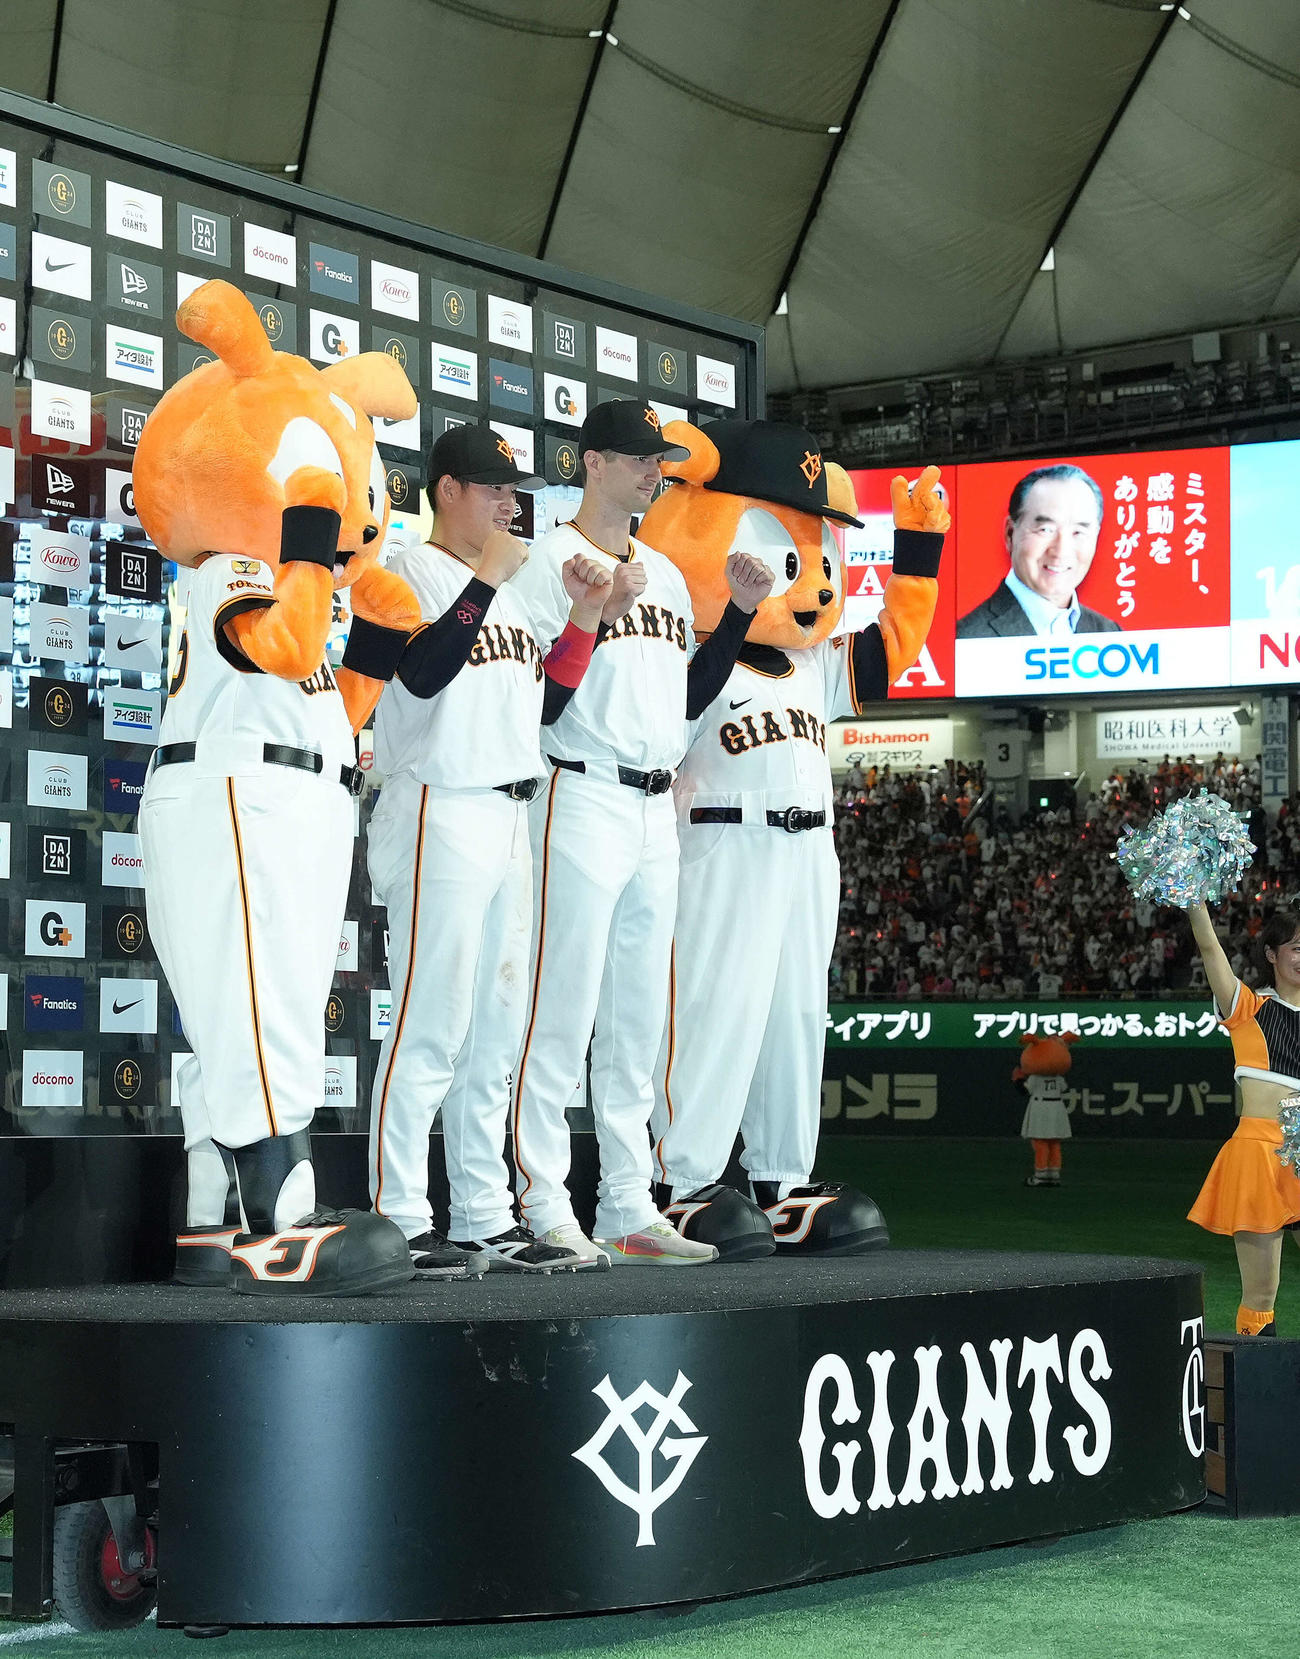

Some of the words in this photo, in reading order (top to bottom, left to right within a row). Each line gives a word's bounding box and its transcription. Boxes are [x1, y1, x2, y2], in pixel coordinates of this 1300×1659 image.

[121, 217, 148, 232] GIANTS
[252, 246, 289, 265] docomo
[325, 267, 353, 284] Fanatics
[382, 281, 410, 300] Kowa
[117, 348, 153, 367] アイダ設計
[603, 346, 632, 363] docomo
[440, 364, 469, 380] アイダ設計
[503, 380, 528, 396] Fanatics
[48, 415, 75, 431] GIANTS
[1146, 472, 1175, 564] 感動を
[1184, 472, 1209, 595] ミスター、
[1113, 475, 1140, 617] ありがとう
[44, 549, 79, 567] Kowa
[127, 559, 142, 572] DA
[127, 572, 142, 586] ZN
[226, 579, 272, 592] TOKYO
[856, 565, 886, 595] A
[600, 603, 687, 651] IANTS
[46, 636, 73, 650] GIANTS
[1260, 632, 1300, 669] N
[467, 623, 543, 683] GIANTS
[1024, 643, 1160, 680] SECOM
[115, 709, 151, 724] アイダ設計
[1104, 715, 1233, 741] 昭和医科大学
[843, 728, 930, 746] Bishamon
[998, 743, 1010, 762] 3
[1104, 744, 1139, 752] SHOWA
[1142, 741, 1180, 750] Medical
[1184, 740, 1232, 750] University
[44, 784, 72, 797] GIANTS
[121, 782, 144, 795] Fanat
[49, 841, 65, 855] DA
[49, 855, 65, 868] ZN
[111, 853, 143, 867] docom
[43, 998, 77, 1010] Fanatics
[32, 1072, 73, 1085] docomo
[799, 1328, 1112, 1519] GIANTS
